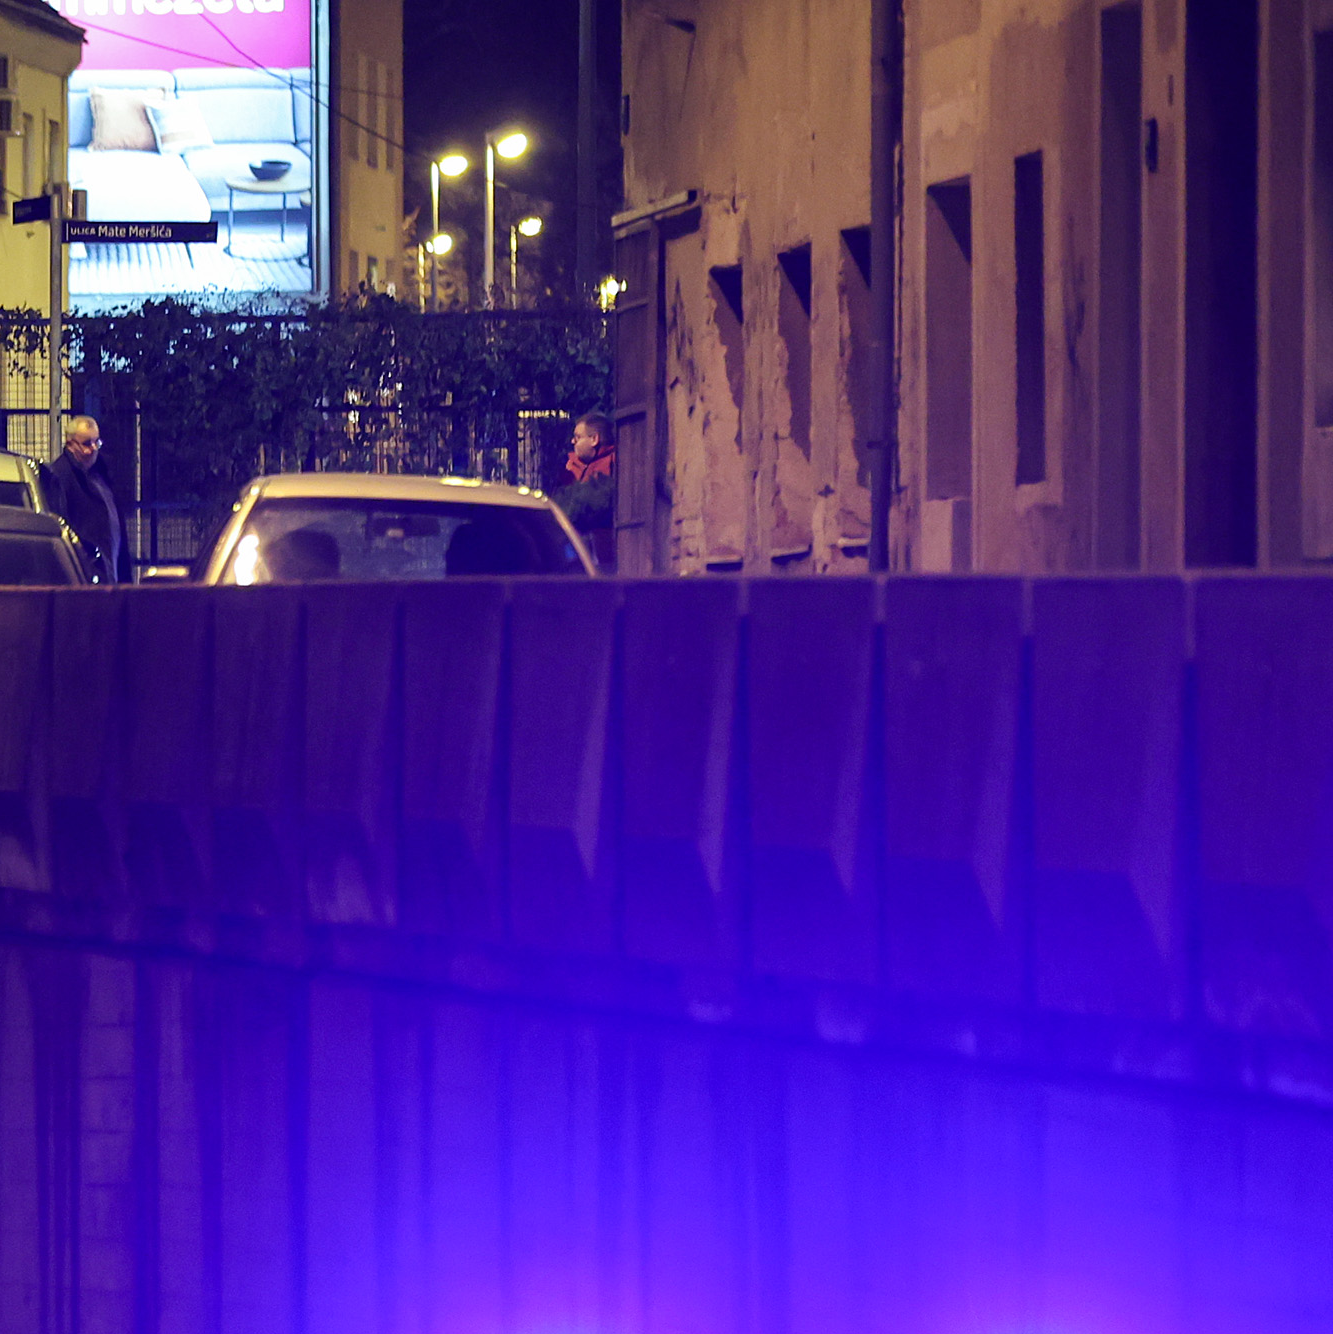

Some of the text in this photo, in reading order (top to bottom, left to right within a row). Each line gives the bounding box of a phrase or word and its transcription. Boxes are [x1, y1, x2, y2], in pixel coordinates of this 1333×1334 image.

[71, 225, 172, 238] ULICA Mate Meršića
